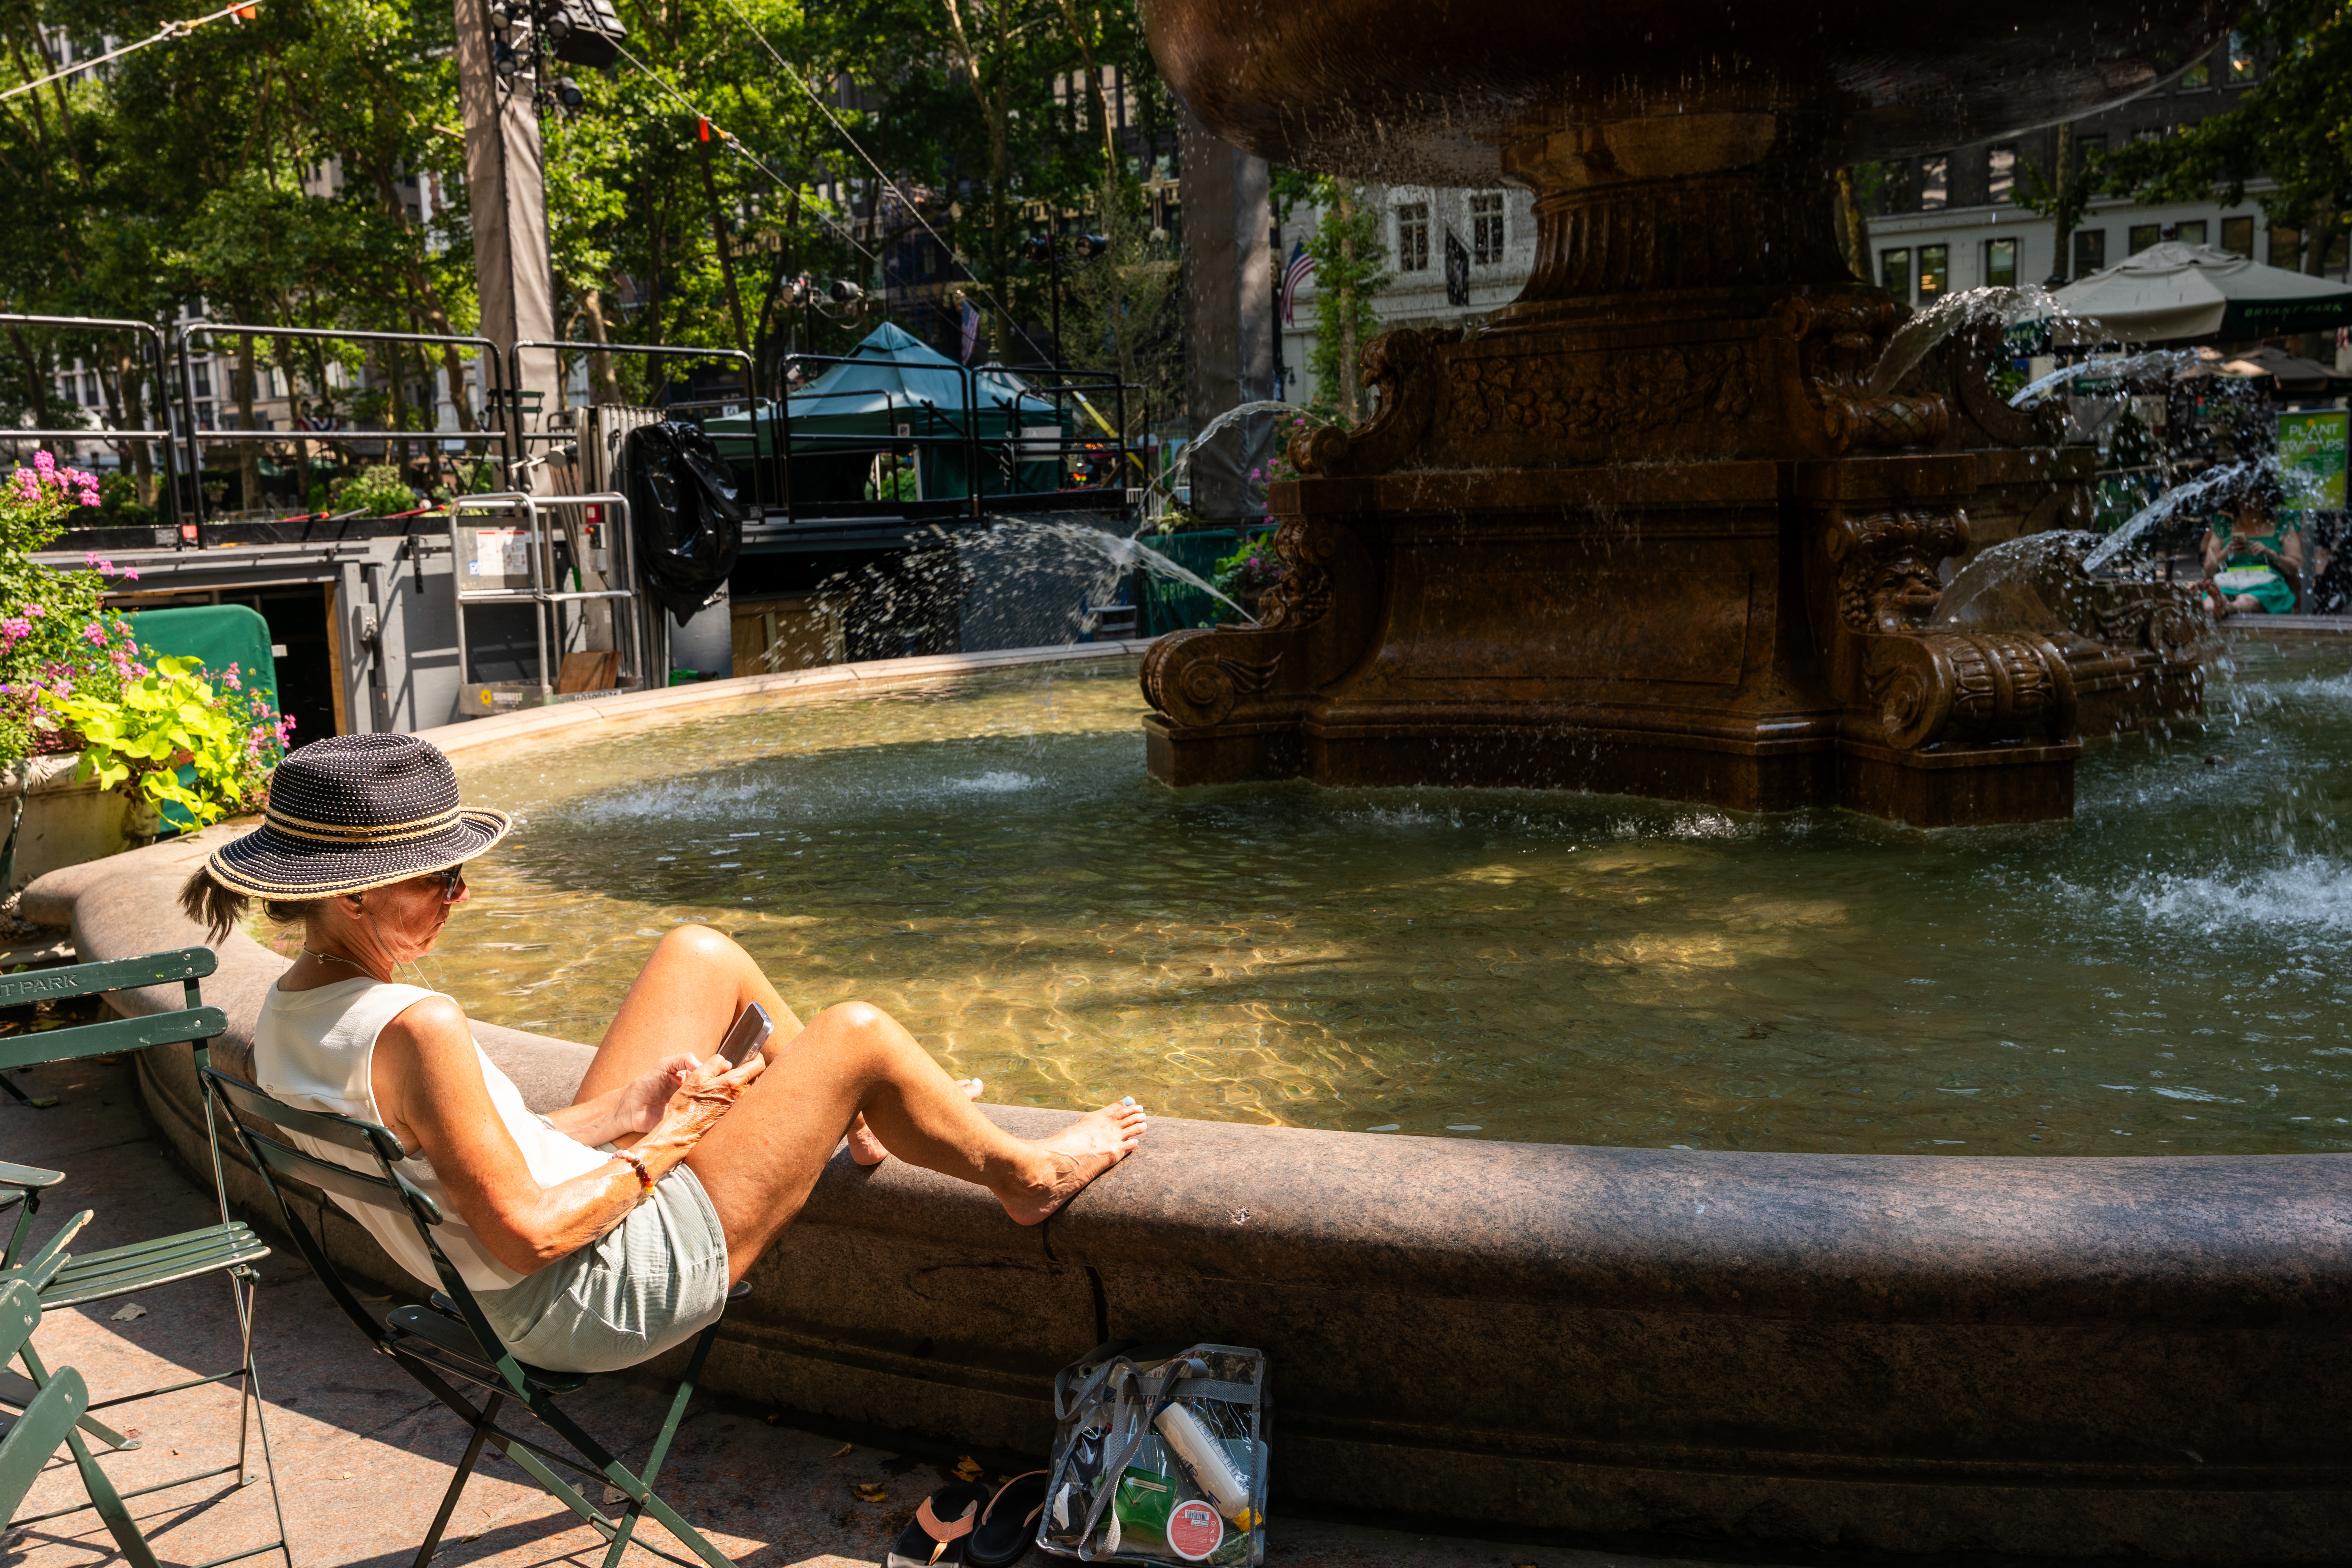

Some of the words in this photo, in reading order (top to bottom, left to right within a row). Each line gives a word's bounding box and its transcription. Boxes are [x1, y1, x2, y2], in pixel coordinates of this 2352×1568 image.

[2304, 302, 2343, 313] PARK
[2289, 423, 2339, 440] PLANT
[2279, 437, 2345, 453] SWAPS
[20, 974, 79, 994] PARK
